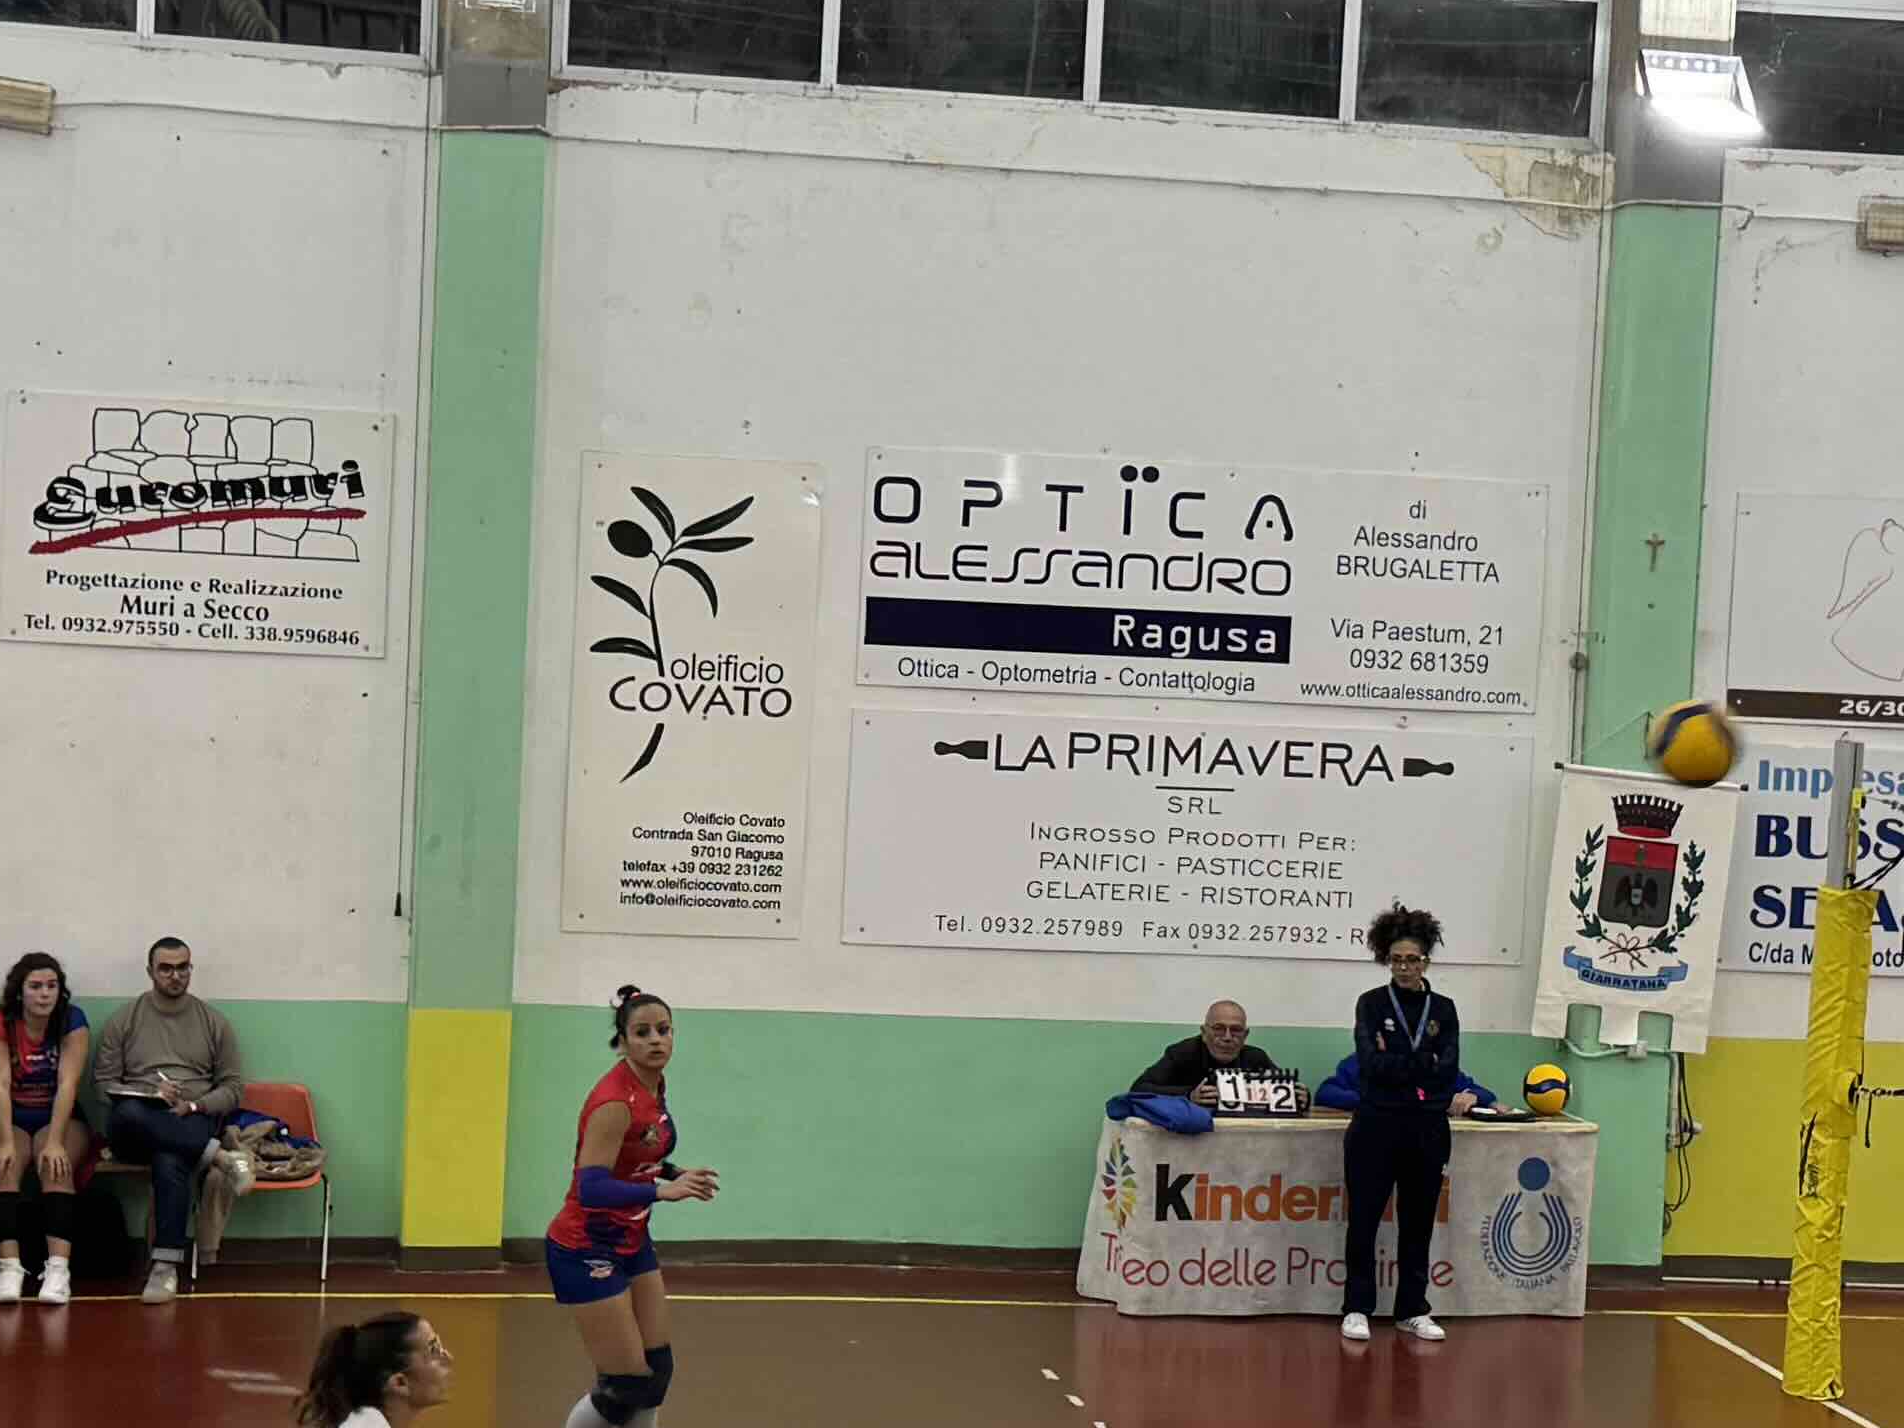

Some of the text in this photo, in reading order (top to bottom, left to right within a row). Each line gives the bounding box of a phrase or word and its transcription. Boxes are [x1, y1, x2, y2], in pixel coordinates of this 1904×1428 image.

[1409, 500, 1427, 519] di
[1353, 525, 1479, 552] Alessandro
[1336, 554, 1500, 583] BRUGALETTA
[46, 569, 344, 600] Progettazione e Realizzazione
[120, 595, 270, 622] Muri a Secco
[24, 614, 360, 647] Tel. 0932.975550 Cell. 338.9596846
[1113, 614, 1277, 658] Ragusa
[1330, 617, 1504, 647] Via Paestum, 21
[670, 652, 784, 686] oleificio
[1349, 648, 1489, 673] 0932 681359
[897, 656, 1256, 694] Ottica Optometria Contattologia
[608, 676, 793, 719] COVATO
[1300, 681, 1521, 706] www.otticaalessandro.com
[995, 732, 1395, 786] LA PRIMAVERA
[683, 811, 786, 828] Oleificio Covato
[1167, 796, 1222, 815] SRL
[632, 826, 785, 844] Contrada San Giacomo
[690, 845, 784, 862] 97010 Ragusa
[1039, 851, 1344, 880] PANIFICI PASTICCERIE
[623, 859, 667, 873] telefax
[698, 862, 731, 875] 0932
[734, 863, 784, 877] 231262
[619, 876, 783, 894] www.oleificiocovato.com
[1026, 880, 1353, 909] GELATERIE RISTORANTI
[935, 914, 972, 933] Tel.
[980, 916, 1123, 938] 0932.257989
[1142, 920, 1181, 940] Fax
[1187, 922, 1328, 944] 0932.257932
[1748, 942, 1795, 965] C/da
[1273, 1085, 1294, 1109] 2
[1179, 1246, 1276, 1287] delle
